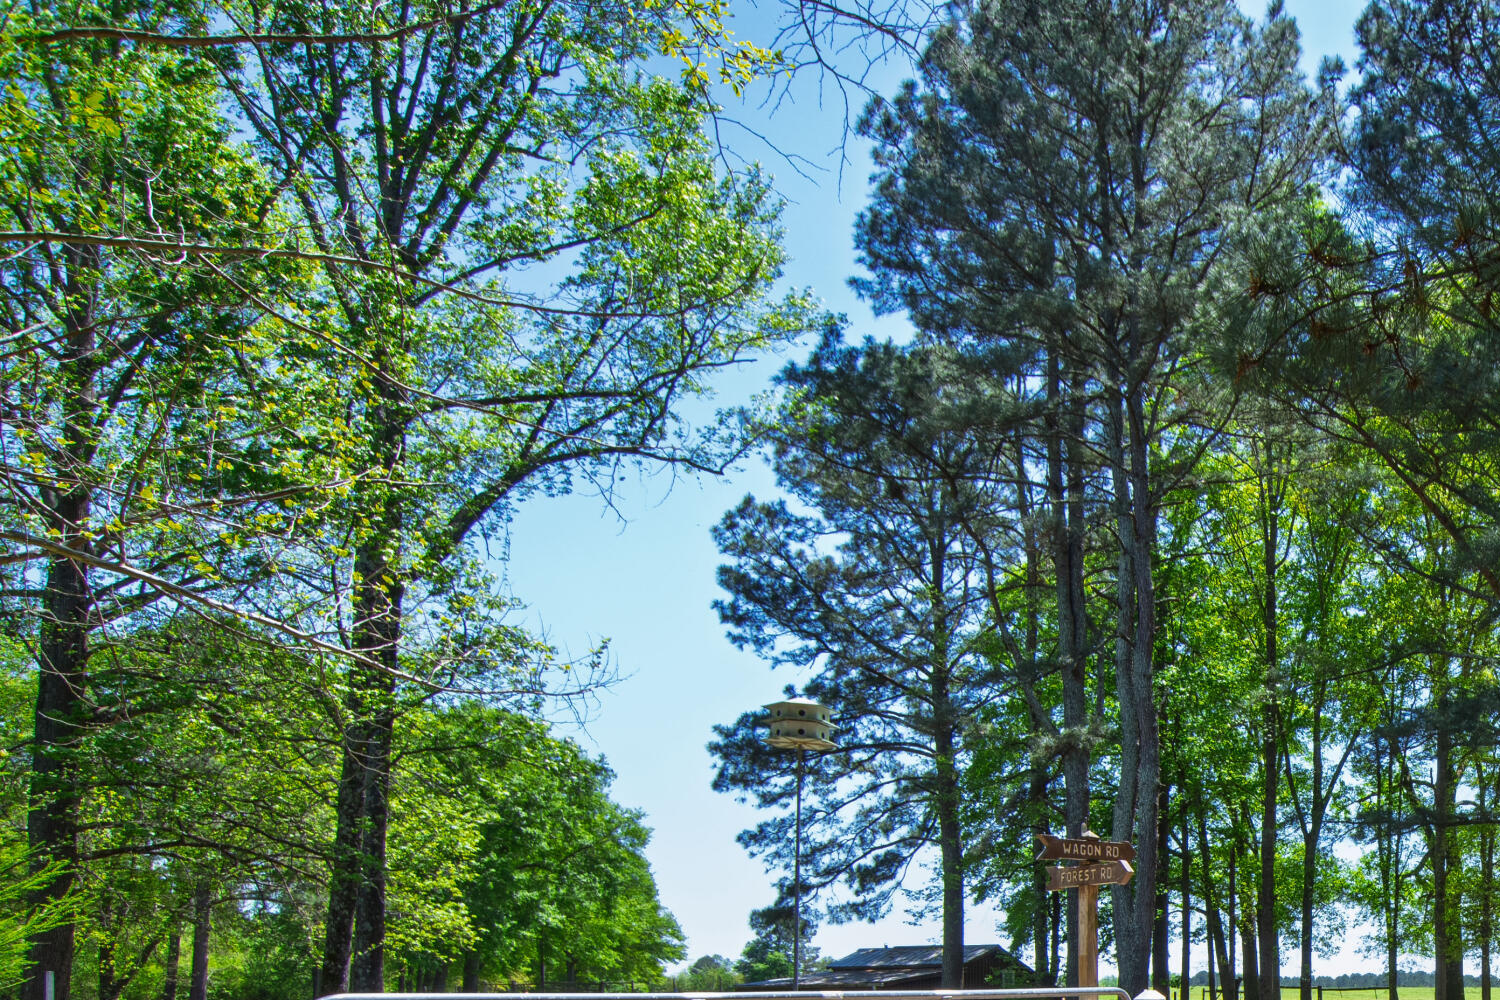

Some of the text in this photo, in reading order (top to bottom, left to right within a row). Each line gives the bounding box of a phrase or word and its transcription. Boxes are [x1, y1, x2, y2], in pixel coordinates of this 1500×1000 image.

[1062, 843, 1119, 857] WAGON RD
[1060, 867, 1112, 882] FOREST RD
